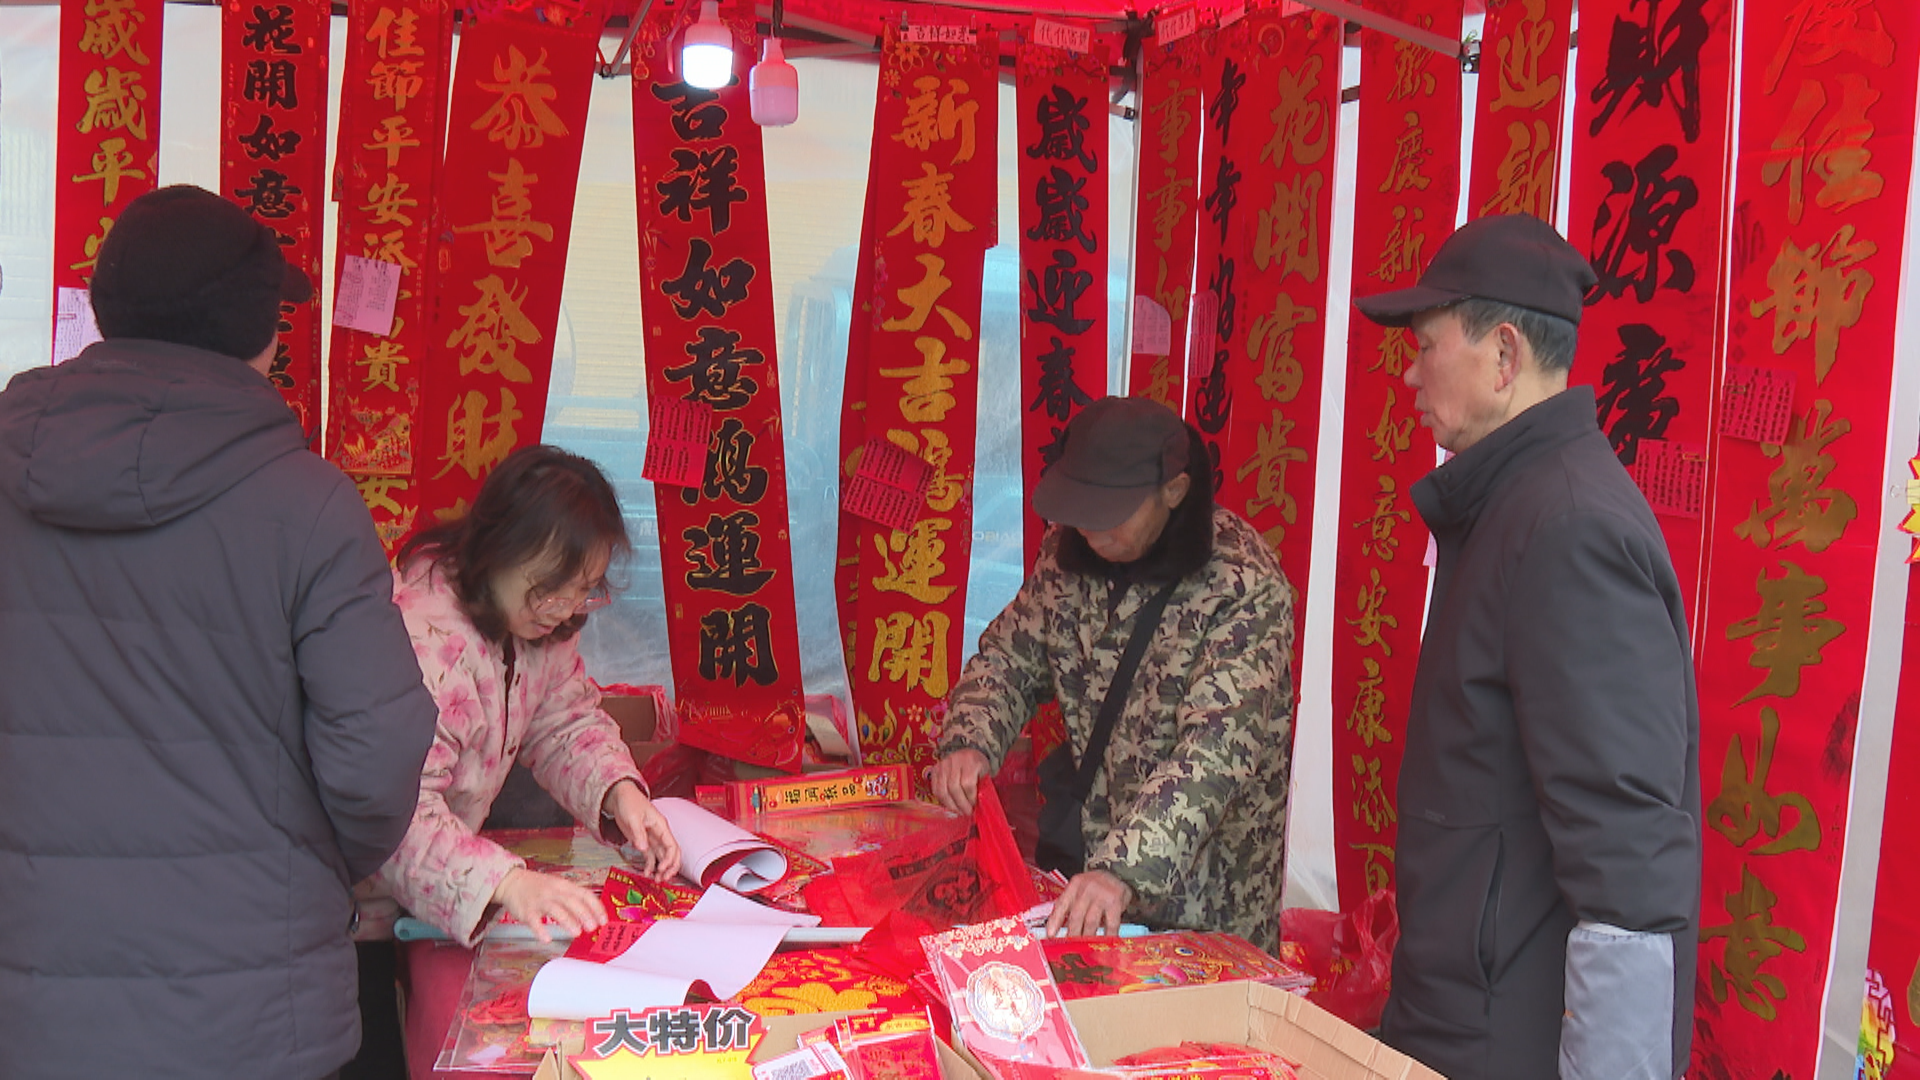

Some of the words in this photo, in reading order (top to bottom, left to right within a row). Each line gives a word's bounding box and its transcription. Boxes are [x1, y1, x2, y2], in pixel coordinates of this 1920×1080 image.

[355, 6, 425, 392] 佳節平安添貴
[431, 44, 570, 521] 恭喜發財
[1236, 54, 1330, 563] 花開富貴
[594, 1007, 757, 1057] 大特价
